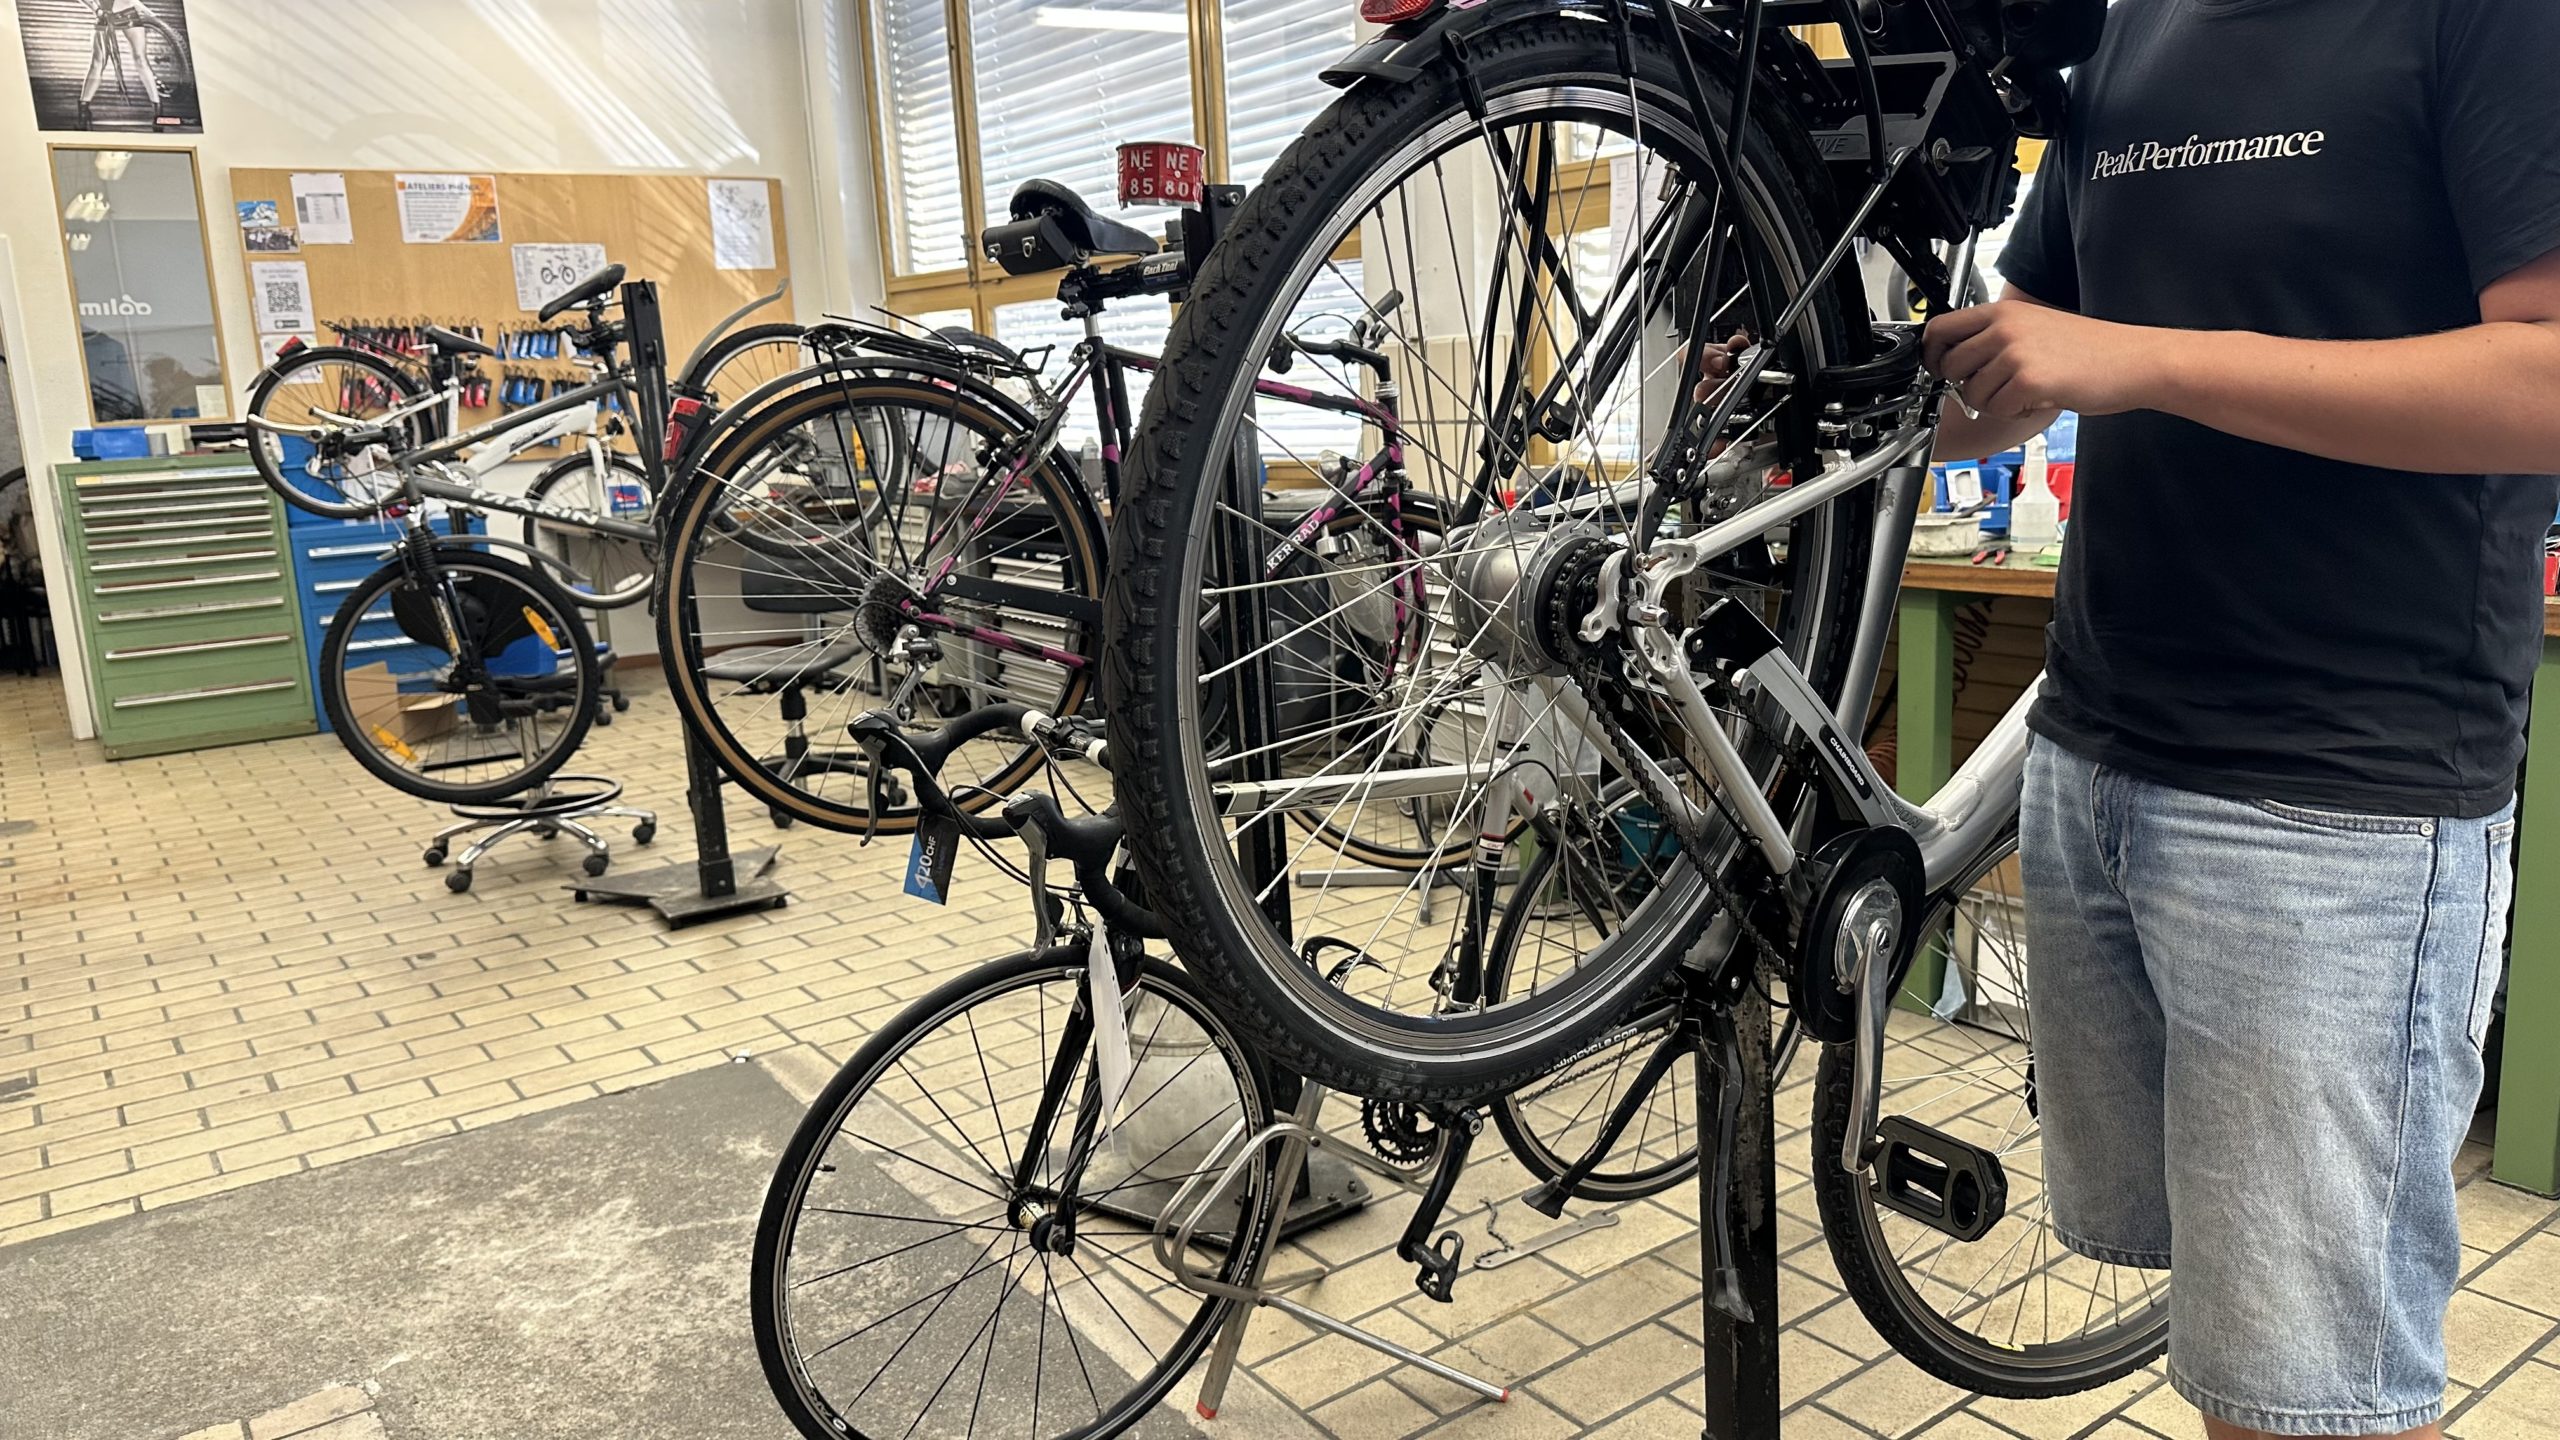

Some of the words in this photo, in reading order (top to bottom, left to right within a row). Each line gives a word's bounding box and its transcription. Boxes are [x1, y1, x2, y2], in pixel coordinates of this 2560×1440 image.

[1130, 150, 1153, 168] NE
[1166, 151, 1189, 171] NE
[1130, 177, 1154, 196] 85
[1165, 180, 1189, 197] 80
[470, 488, 599, 526] MARIN
[1829, 736, 1866, 787] CHAINBOARD
